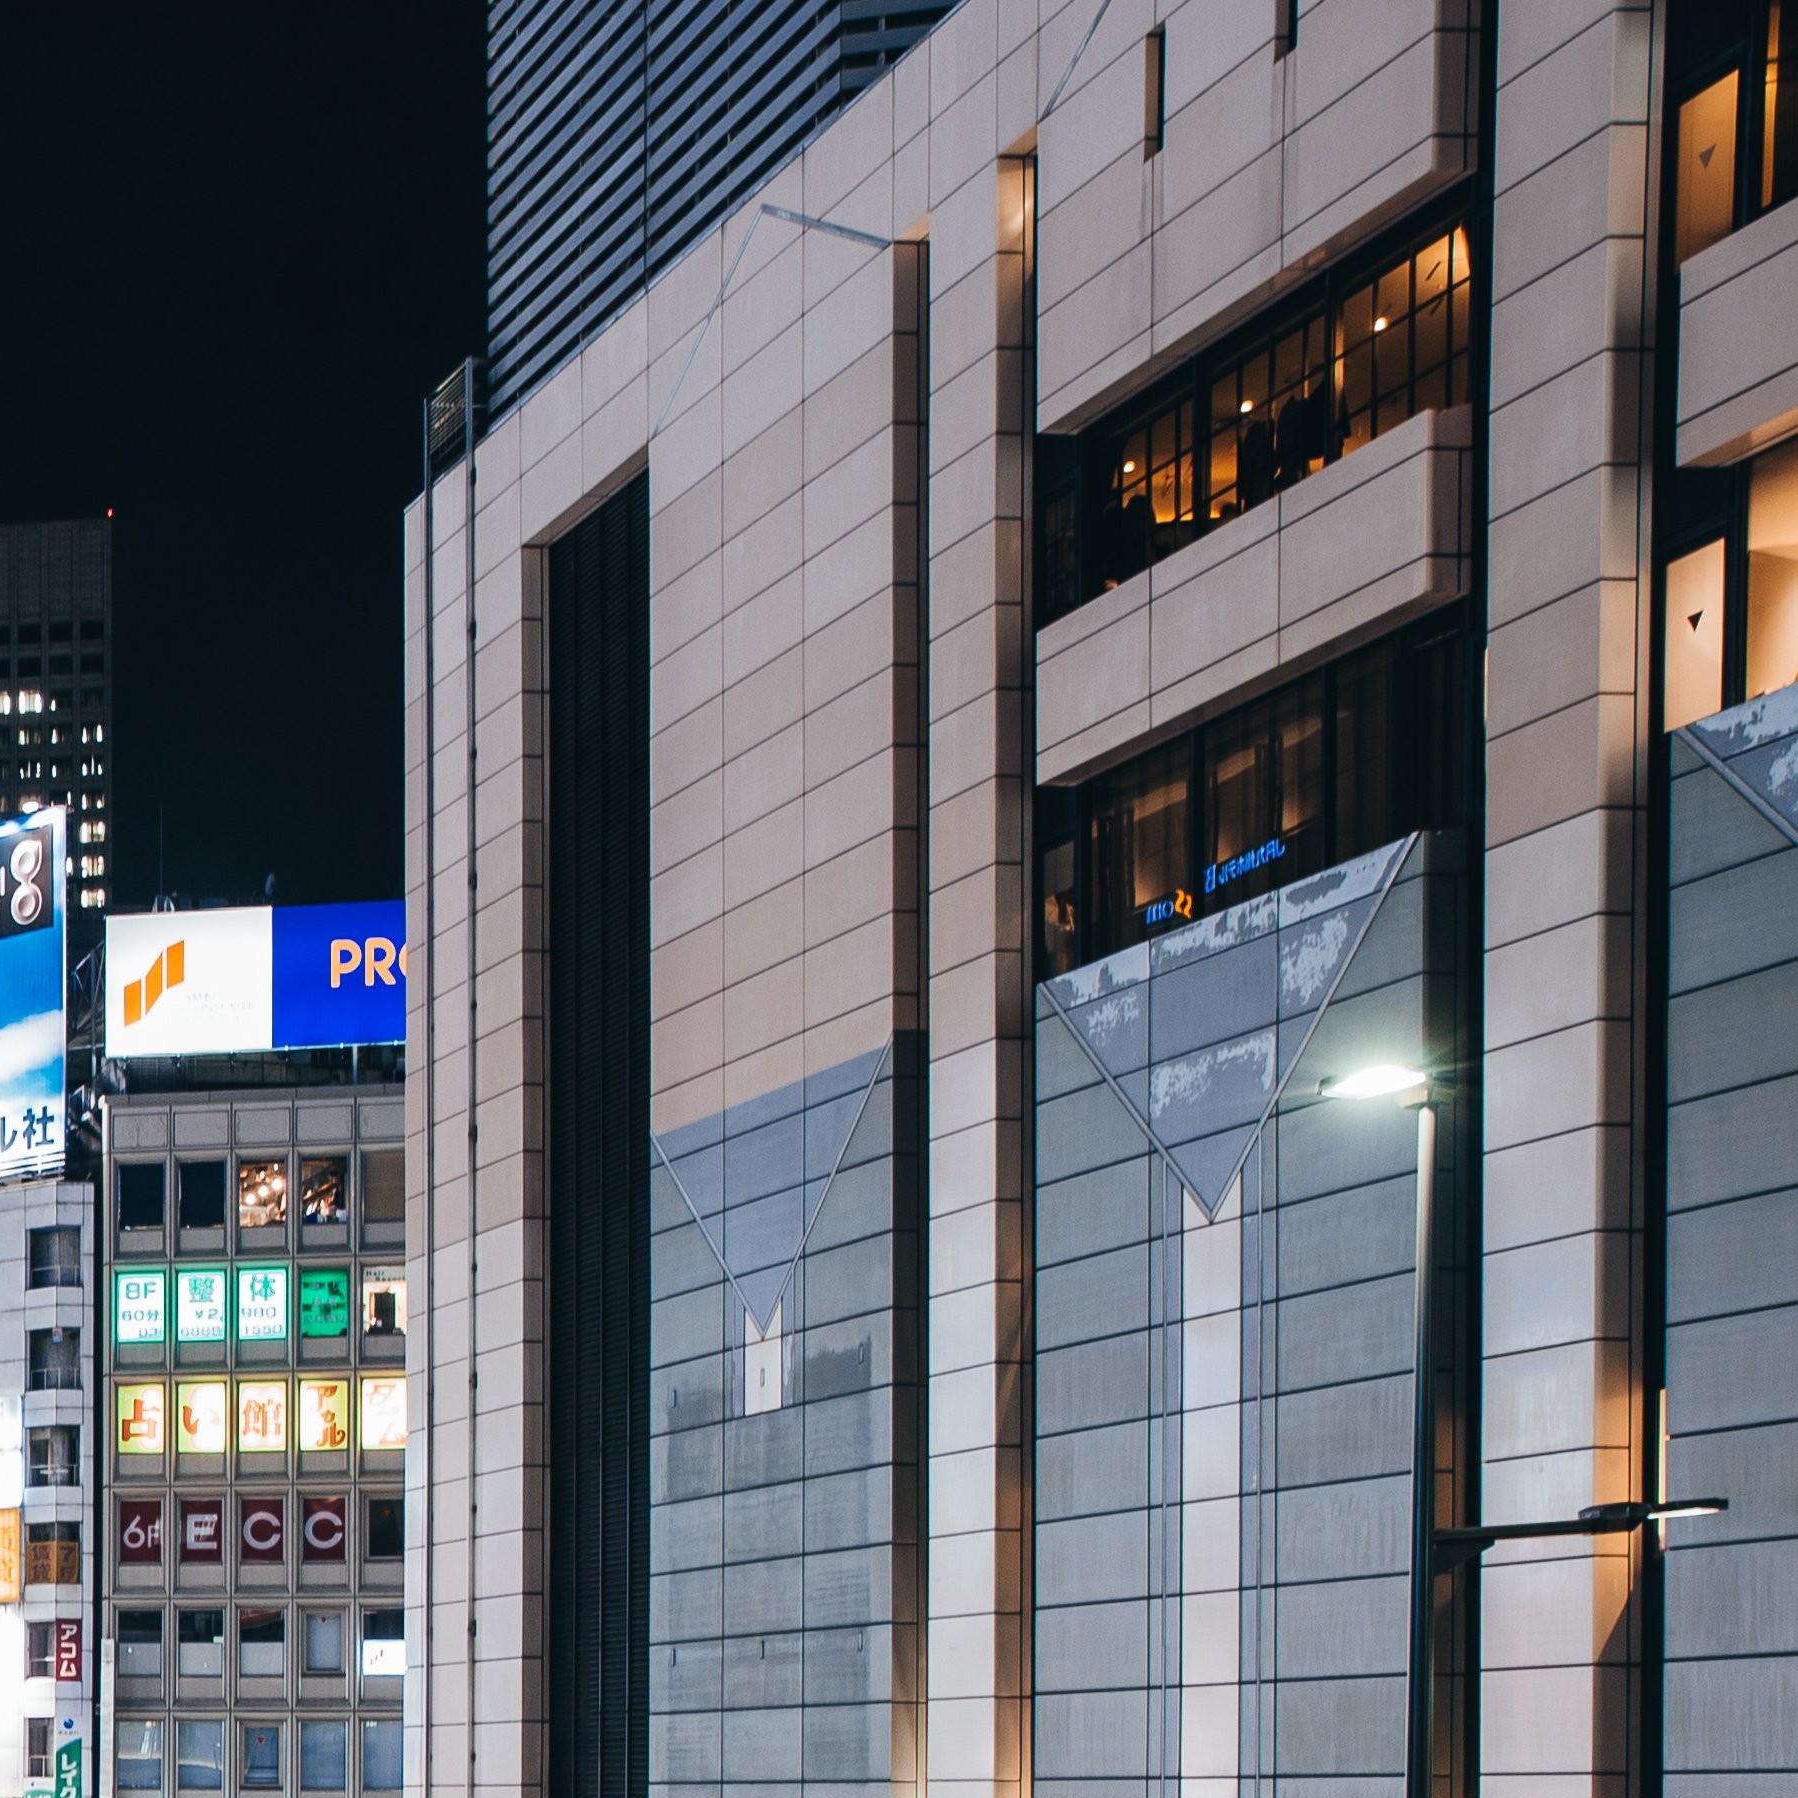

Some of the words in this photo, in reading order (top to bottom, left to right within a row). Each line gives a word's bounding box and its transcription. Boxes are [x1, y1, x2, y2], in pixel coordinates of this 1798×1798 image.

[330, 937, 407, 989] PR
[124, 1281, 157, 1300] 8F
[184, 1511, 344, 1552] ECC
[59, 1624, 78, 1677] アコム
